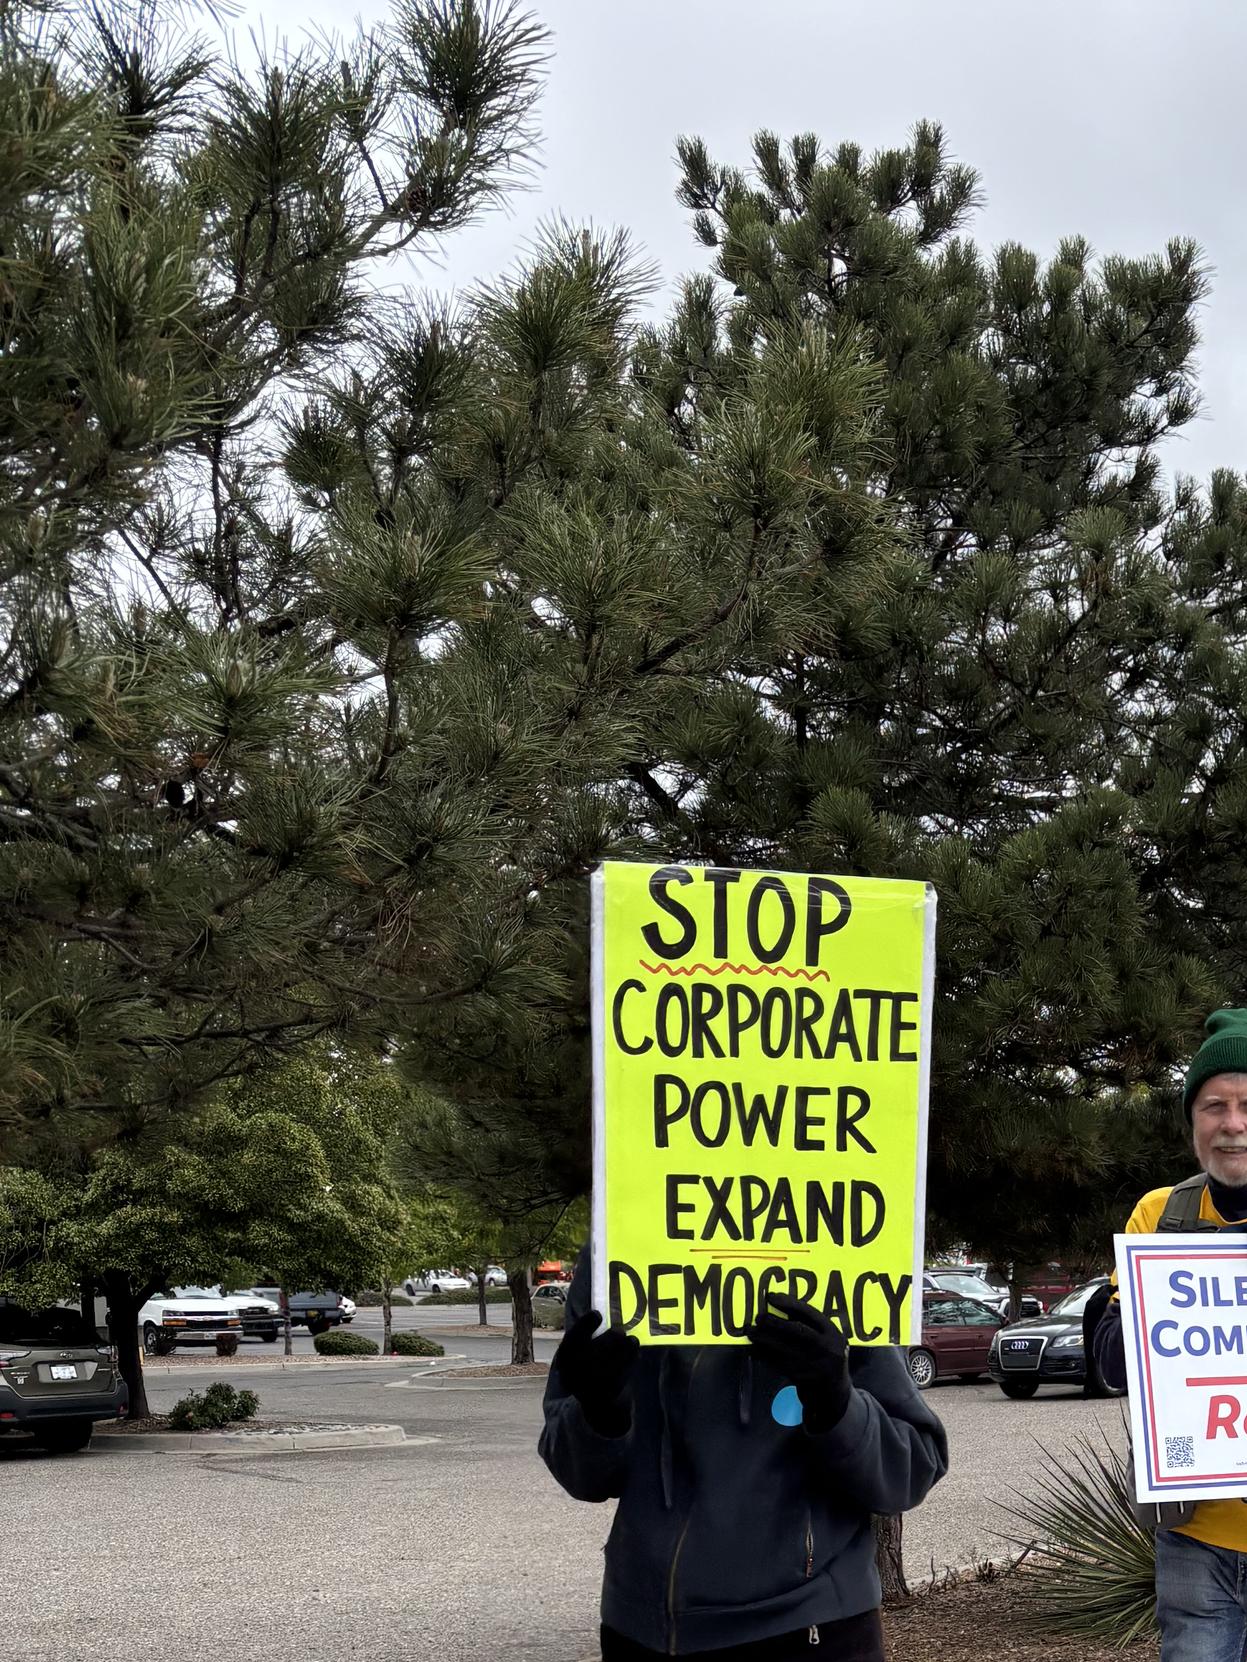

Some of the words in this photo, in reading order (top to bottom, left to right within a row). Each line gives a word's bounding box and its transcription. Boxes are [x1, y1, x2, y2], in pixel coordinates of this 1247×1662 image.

[640, 865, 852, 968] STOP
[613, 978, 919, 1063] CORPORATE
[653, 1073, 877, 1154] POWER
[666, 1173, 886, 1248] EXPAND
